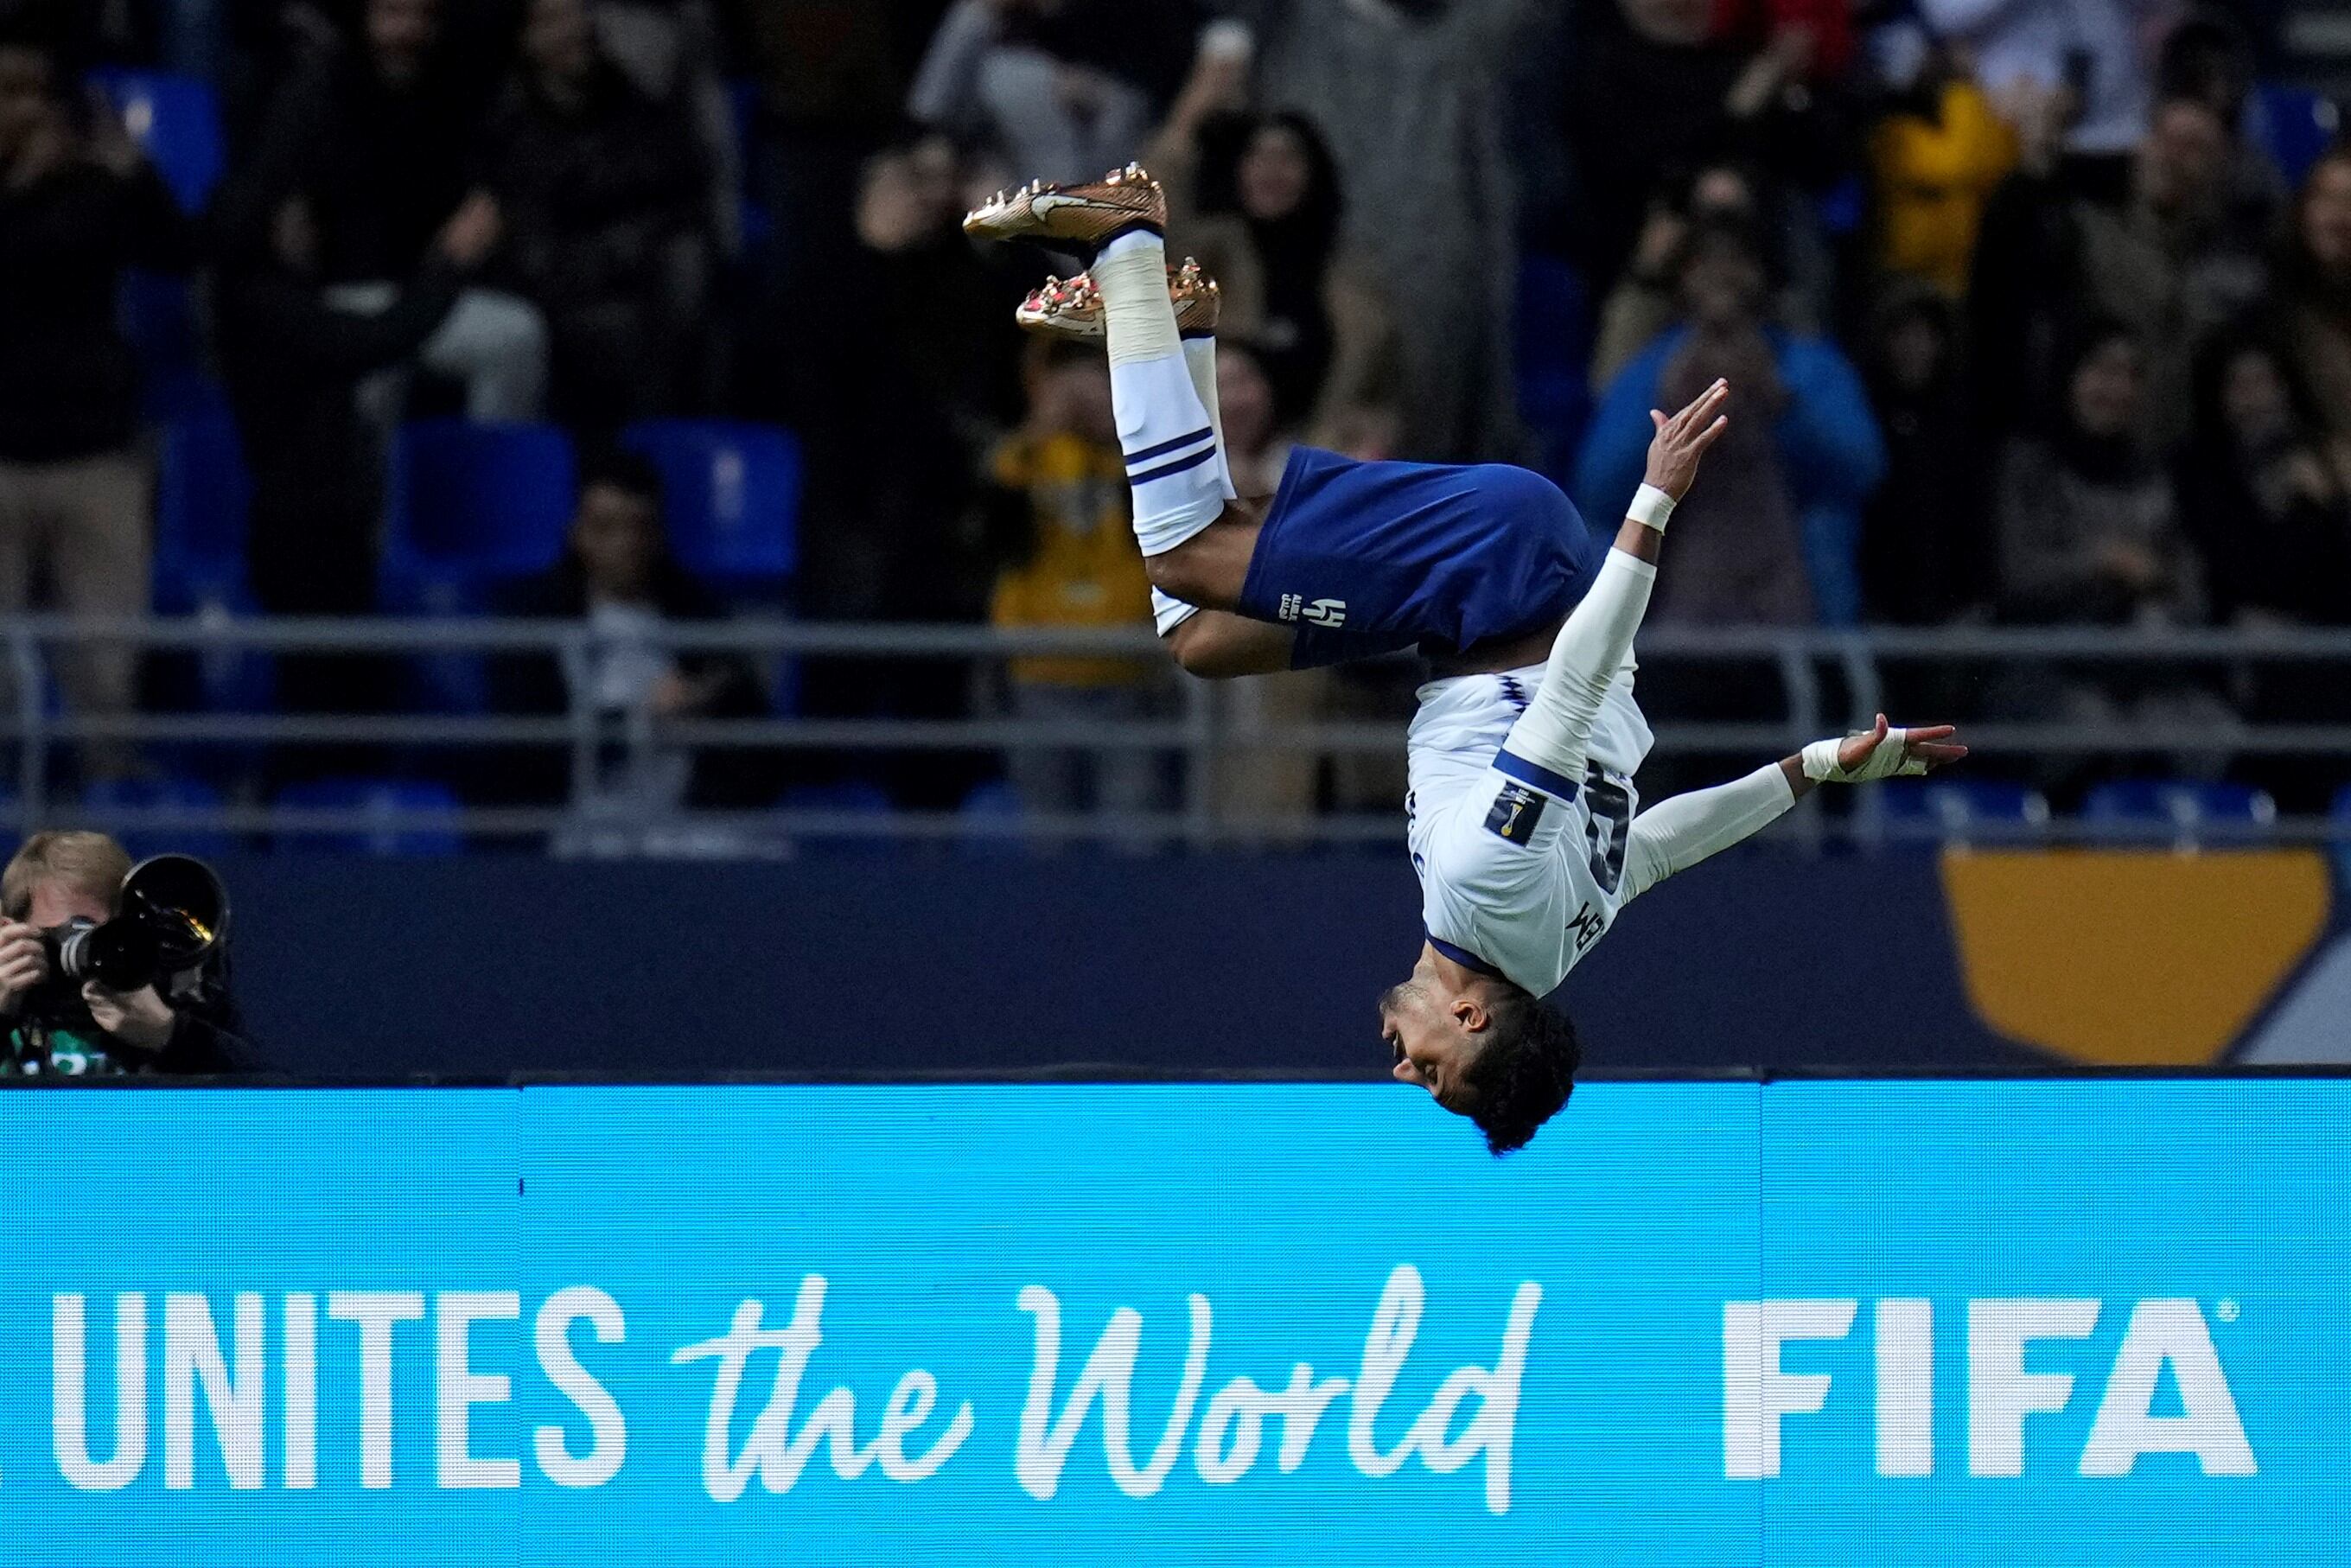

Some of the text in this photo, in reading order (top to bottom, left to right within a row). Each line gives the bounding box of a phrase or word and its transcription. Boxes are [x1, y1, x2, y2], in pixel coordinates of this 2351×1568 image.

[52, 1264, 1543, 1516] UNITES the World
[1722, 1297, 2259, 1480] FIFA
